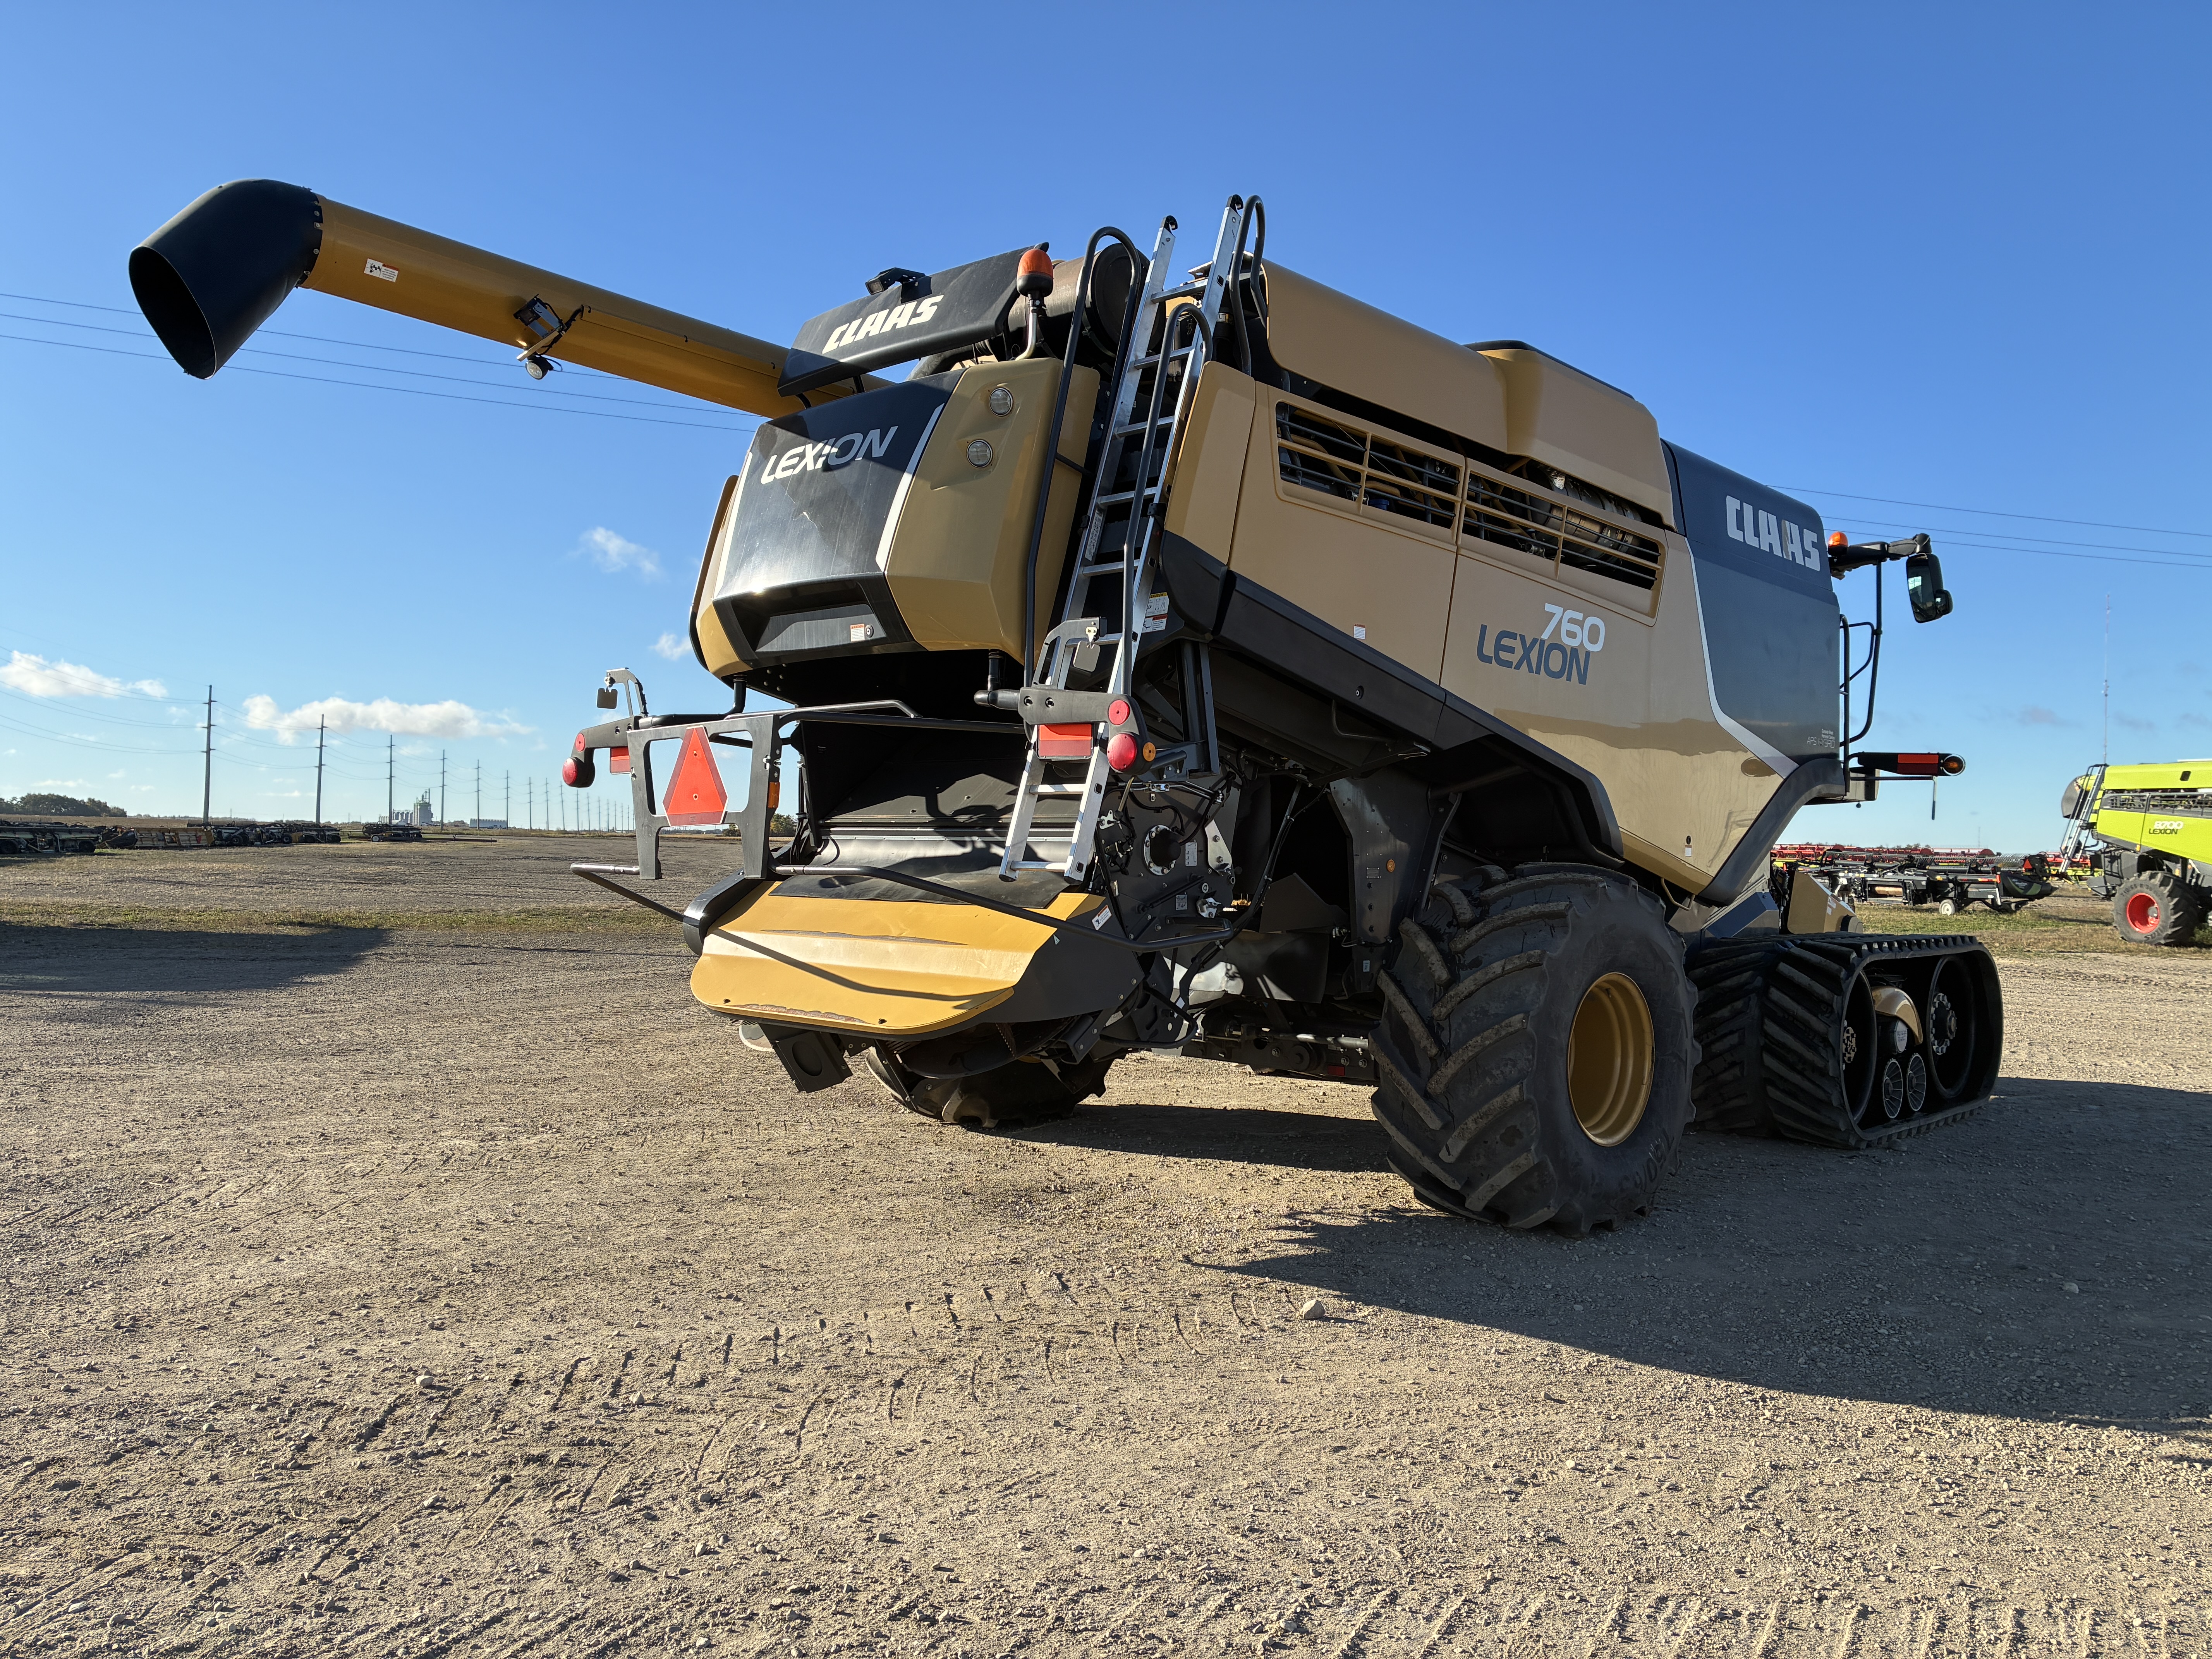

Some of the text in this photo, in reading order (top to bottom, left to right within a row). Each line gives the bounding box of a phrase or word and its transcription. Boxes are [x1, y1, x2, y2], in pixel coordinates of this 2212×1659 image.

[822, 295, 944, 354] CLAAS
[760, 426, 898, 484] LEXION
[1726, 495, 1820, 572] CLAAS
[1476, 624, 1590, 685] LEXION
[1541, 603, 1605, 652] 760
[1807, 737, 1817, 745] APS
[2154, 821, 2183, 829] 8700
